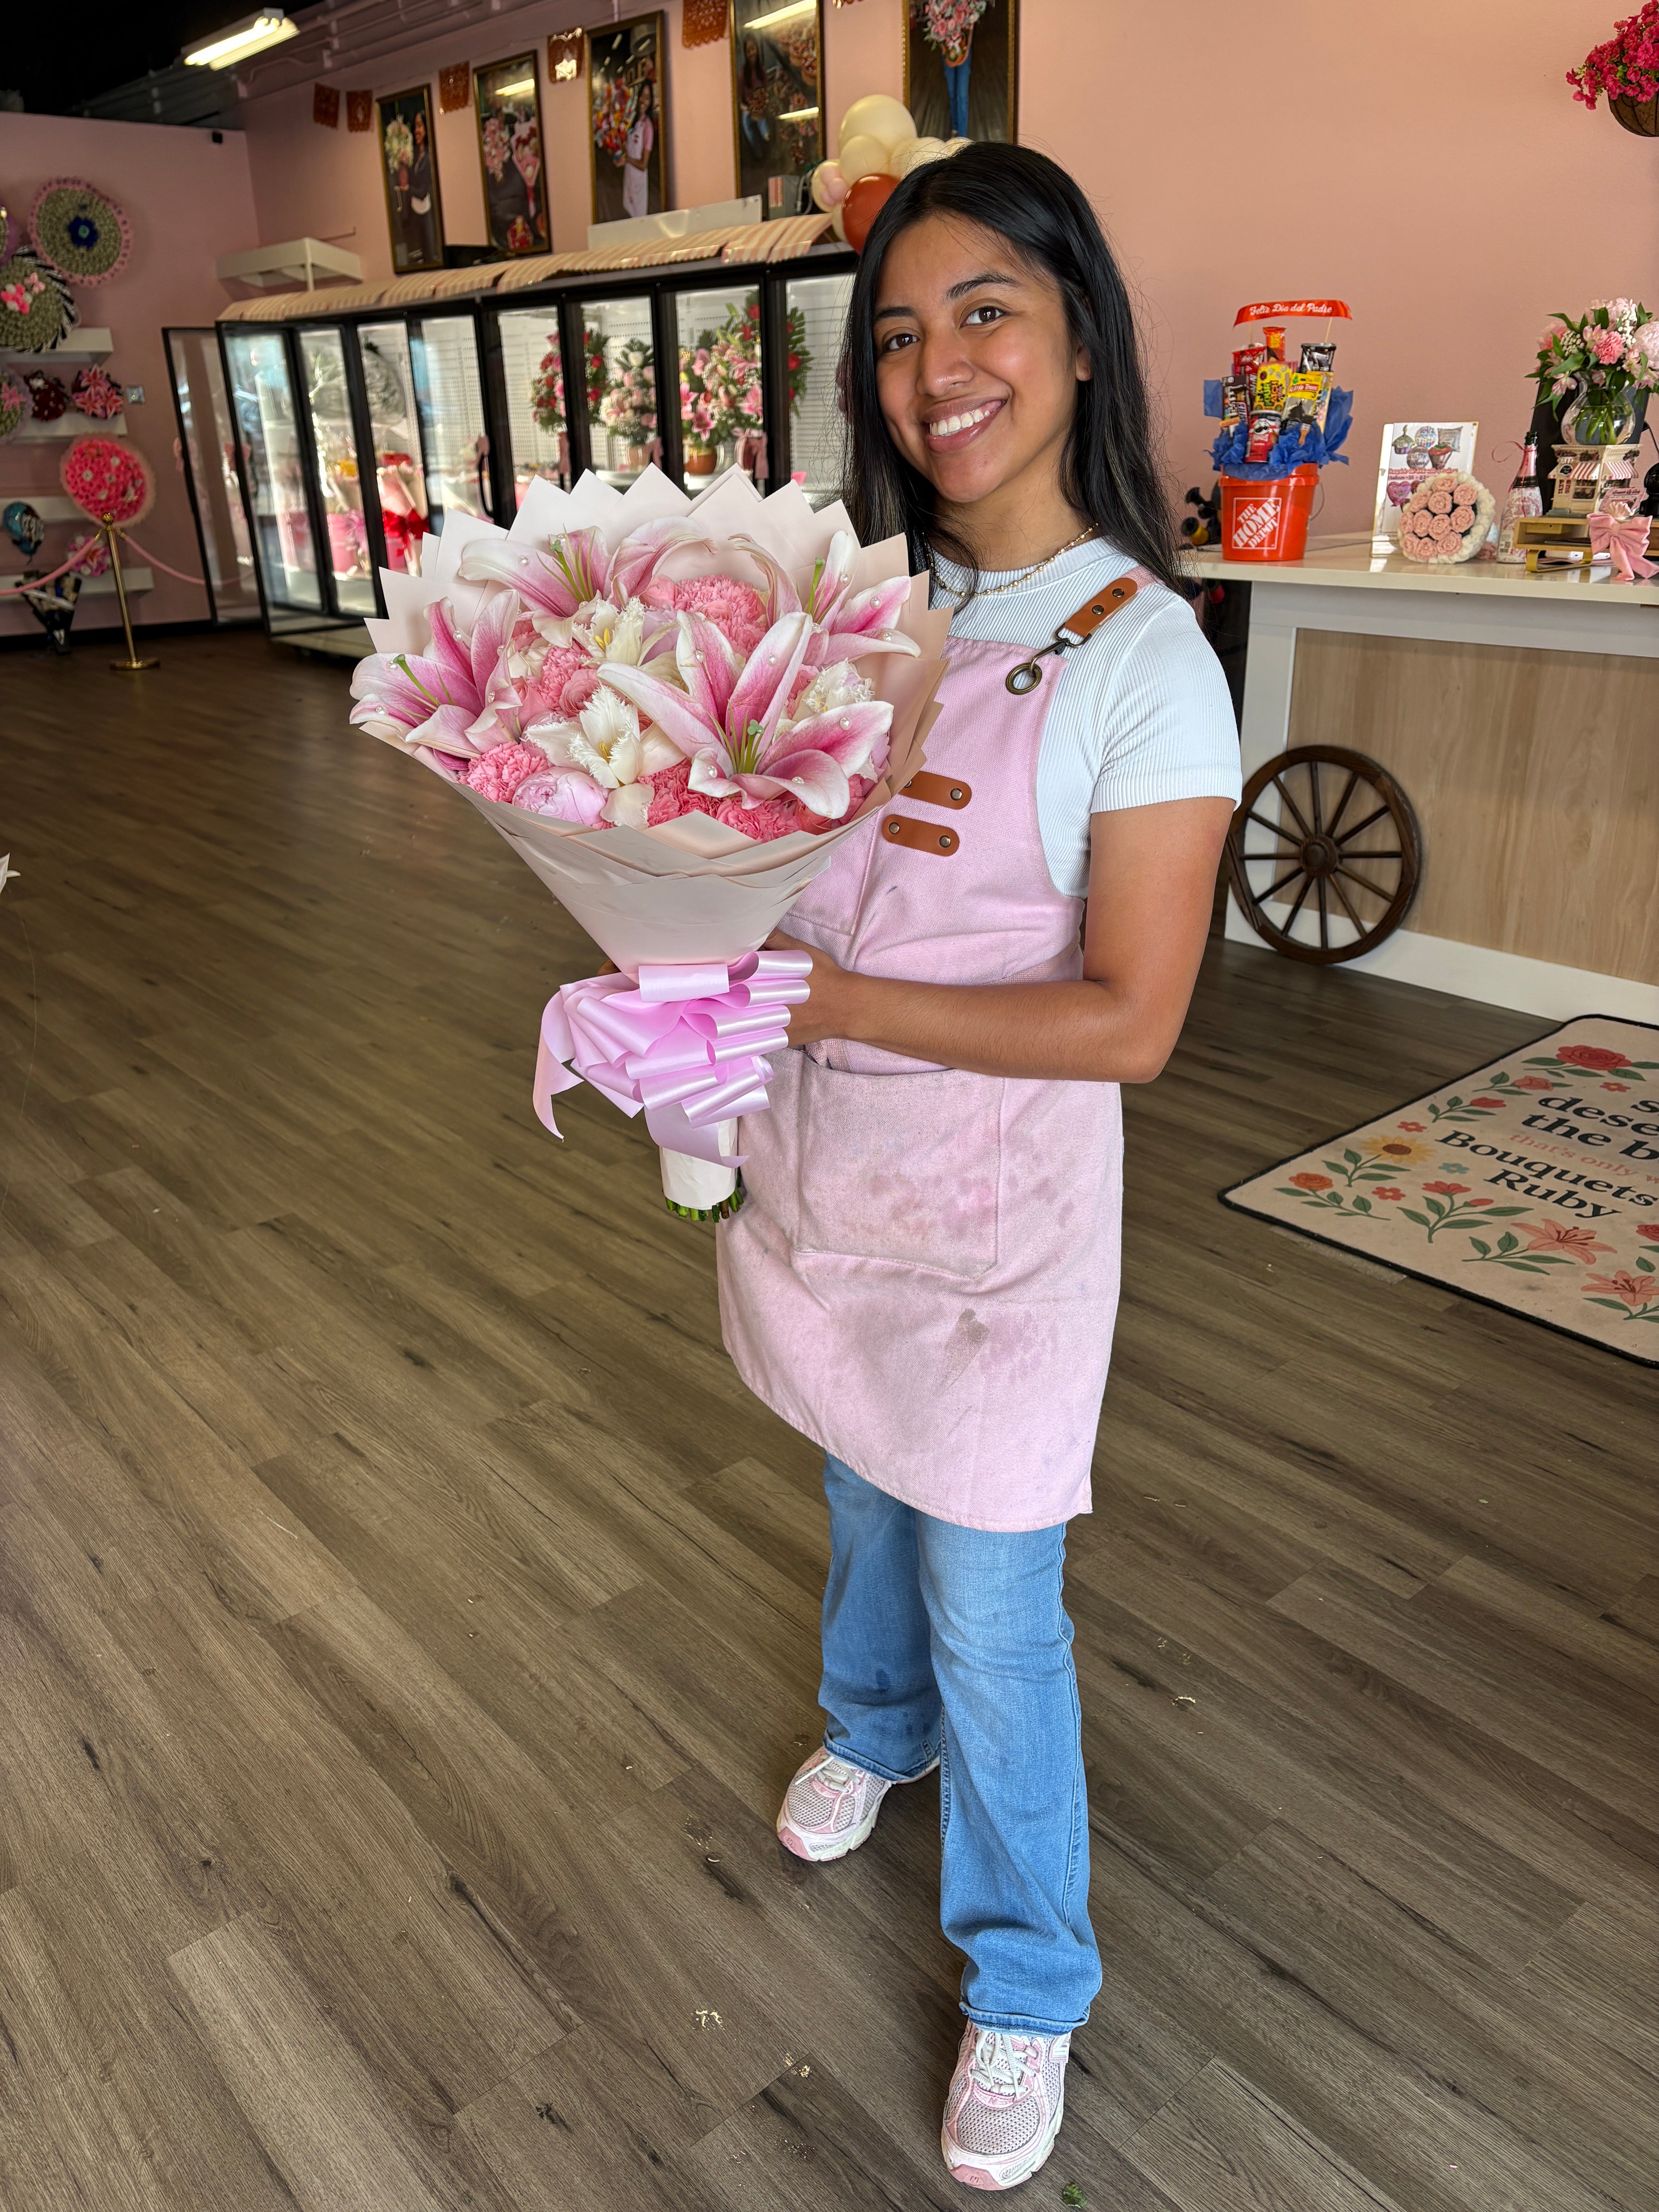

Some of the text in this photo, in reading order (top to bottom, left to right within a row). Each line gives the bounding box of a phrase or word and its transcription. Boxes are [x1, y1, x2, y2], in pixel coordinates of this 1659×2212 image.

[1291, 303, 1305, 312] del
[1307, 303, 1333, 313] Padre
[1233, 498, 1280, 547] HOME
[1237, 503, 1257, 523] THE
[1248, 517, 1278, 547] DEPOT
[1522, 1114, 1611, 1146] the
[1435, 1130, 1659, 1206] Bouquets
[1510, 1134, 1576, 1158] that's
[1580, 1157, 1638, 1176] only
[1483, 1169, 1622, 1218] Ruby
